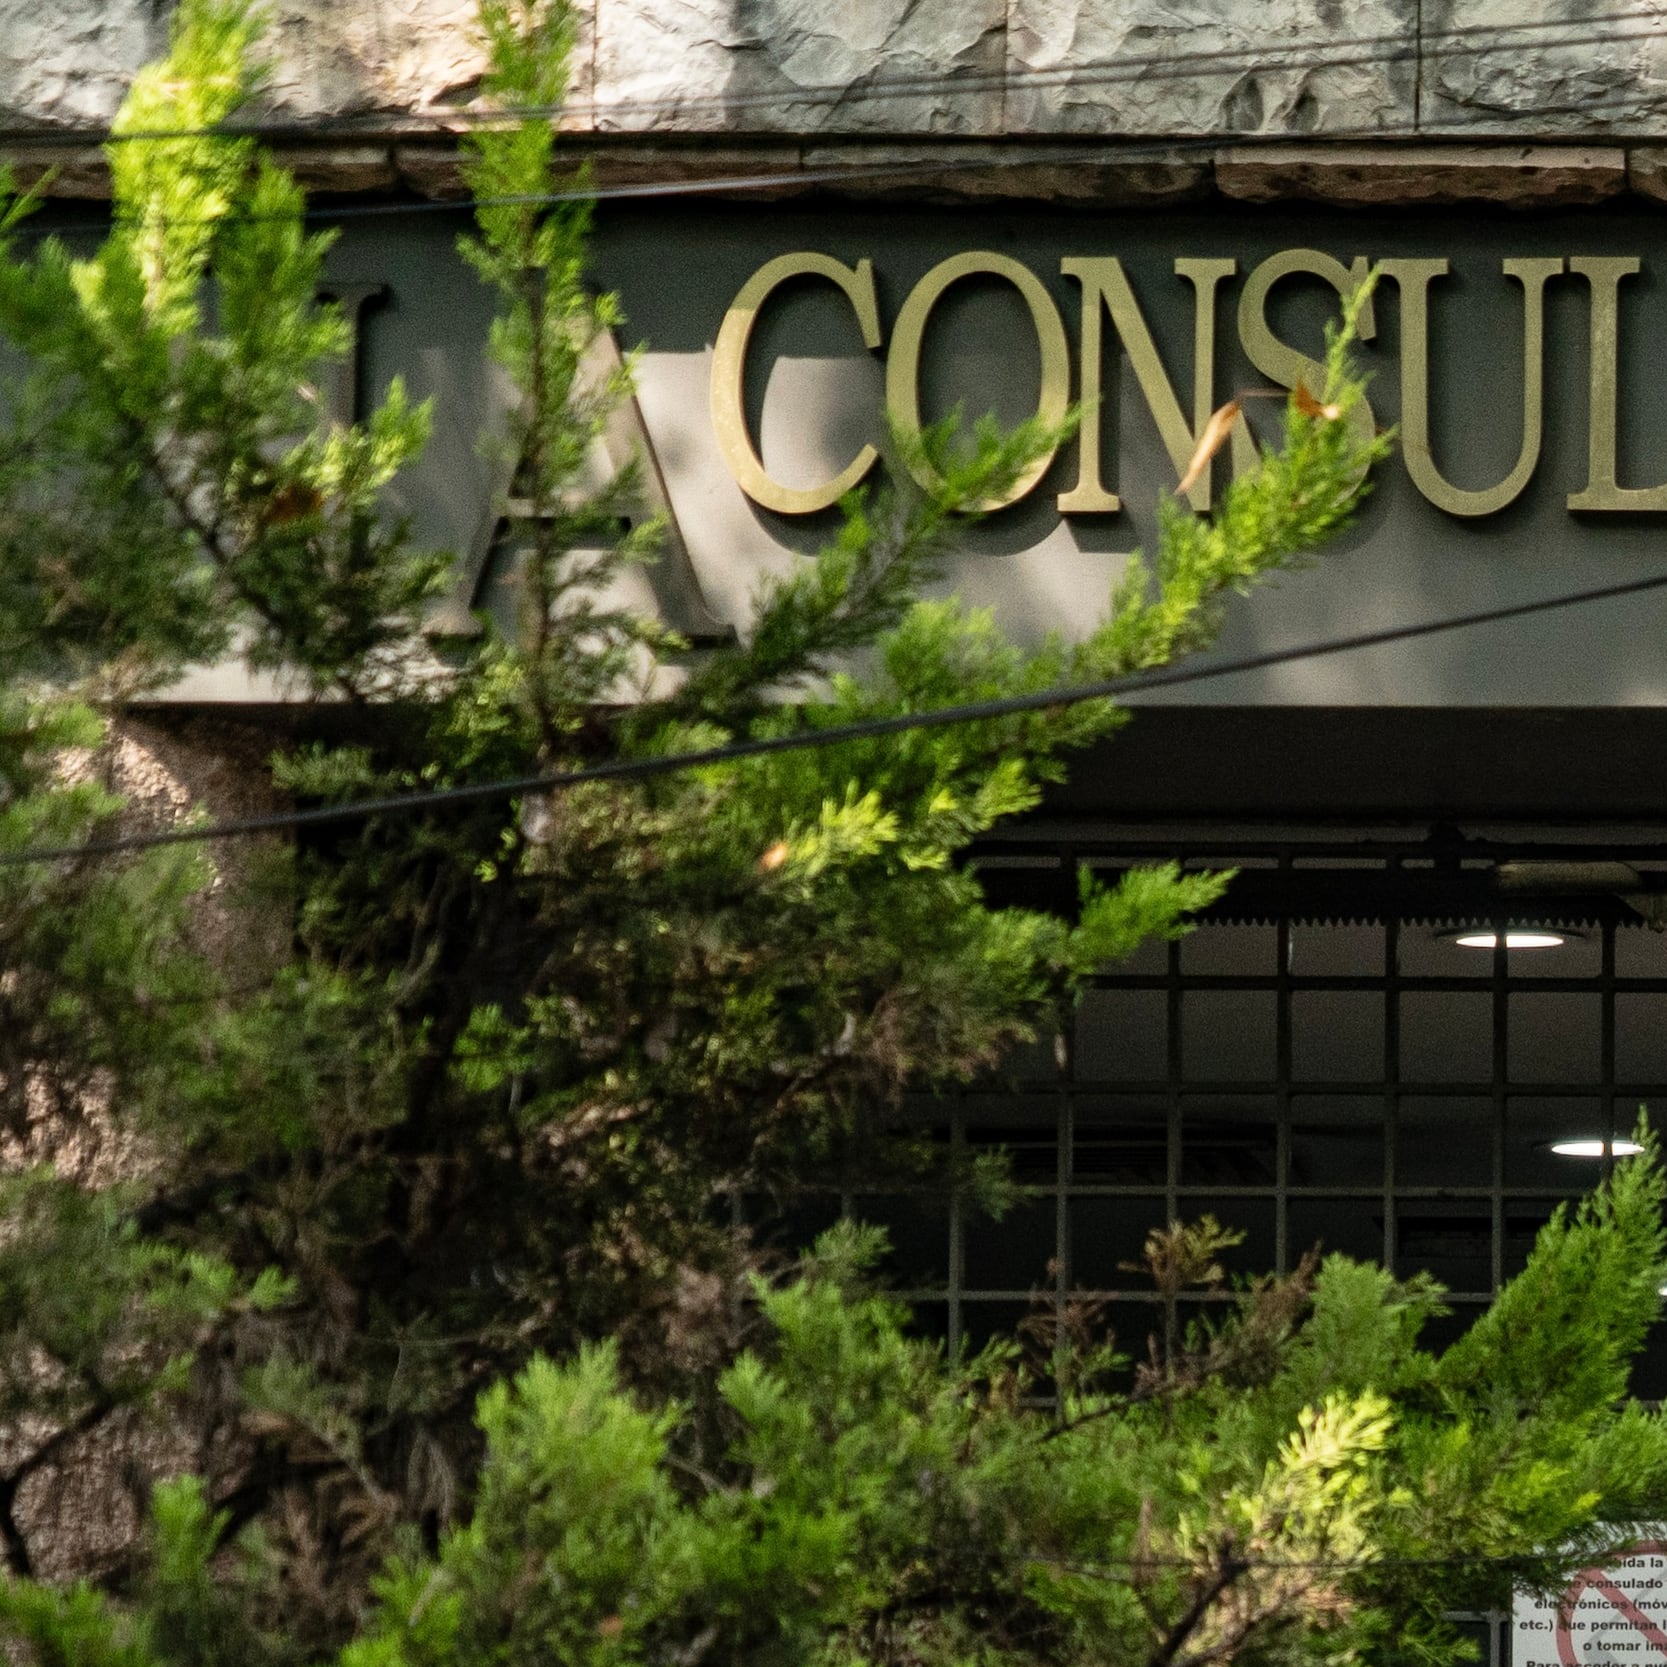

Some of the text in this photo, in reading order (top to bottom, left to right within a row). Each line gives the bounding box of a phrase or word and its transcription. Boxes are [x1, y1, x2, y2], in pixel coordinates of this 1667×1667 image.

[1650, 1558, 1663, 1568] la
[1587, 1578, 1663, 1589] consulado
[1534, 1599, 1628, 1610] eletrónicos
[1519, 1619, 1554, 1632] etc.)
[1591, 1619, 1657, 1633] permitan
[1583, 1642, 1591, 1651] o
[1597, 1641, 1640, 1651] tomar
